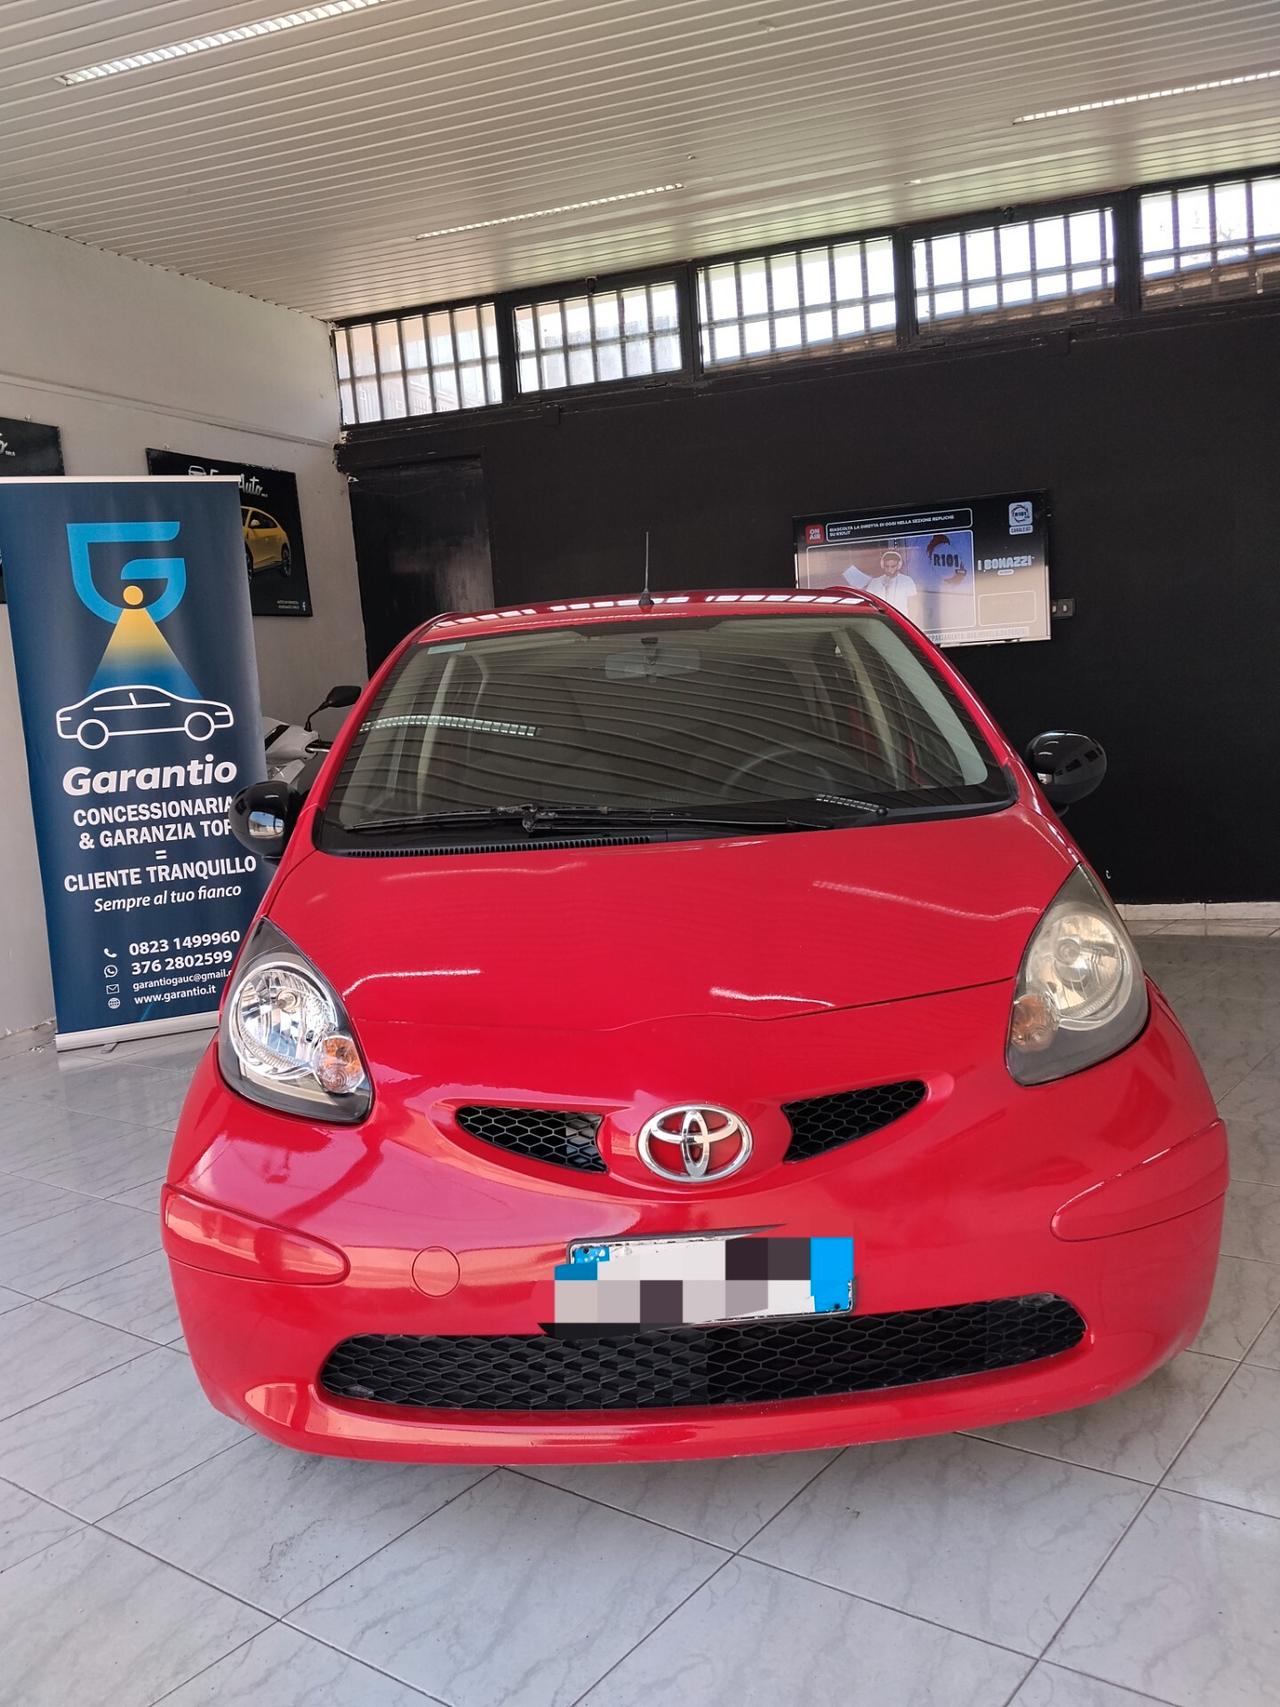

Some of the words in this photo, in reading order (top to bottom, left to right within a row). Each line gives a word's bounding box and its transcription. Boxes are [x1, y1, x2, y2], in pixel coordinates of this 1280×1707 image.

[933, 553, 959, 567] R101
[984, 555, 1032, 570] BONAZZI
[62, 753, 238, 796] Garantio
[73, 795, 233, 827] CONCESSIONARIA
[78, 832, 95, 850] &
[99, 822, 196, 848] GARANZIA
[63, 868, 142, 892] CLIENTE
[145, 855, 257, 882] TRANQUILLO
[93, 893, 151, 913] Sempre
[153, 889, 168, 905] al
[170, 888, 195, 904] tuo
[197, 885, 242, 901] fianco
[128, 939, 170, 956] 0823
[173, 930, 241, 951] 1499960
[131, 960, 162, 976] 376
[165, 950, 233, 971] 2802599
[134, 984, 217, 1005] www.garantio.it
